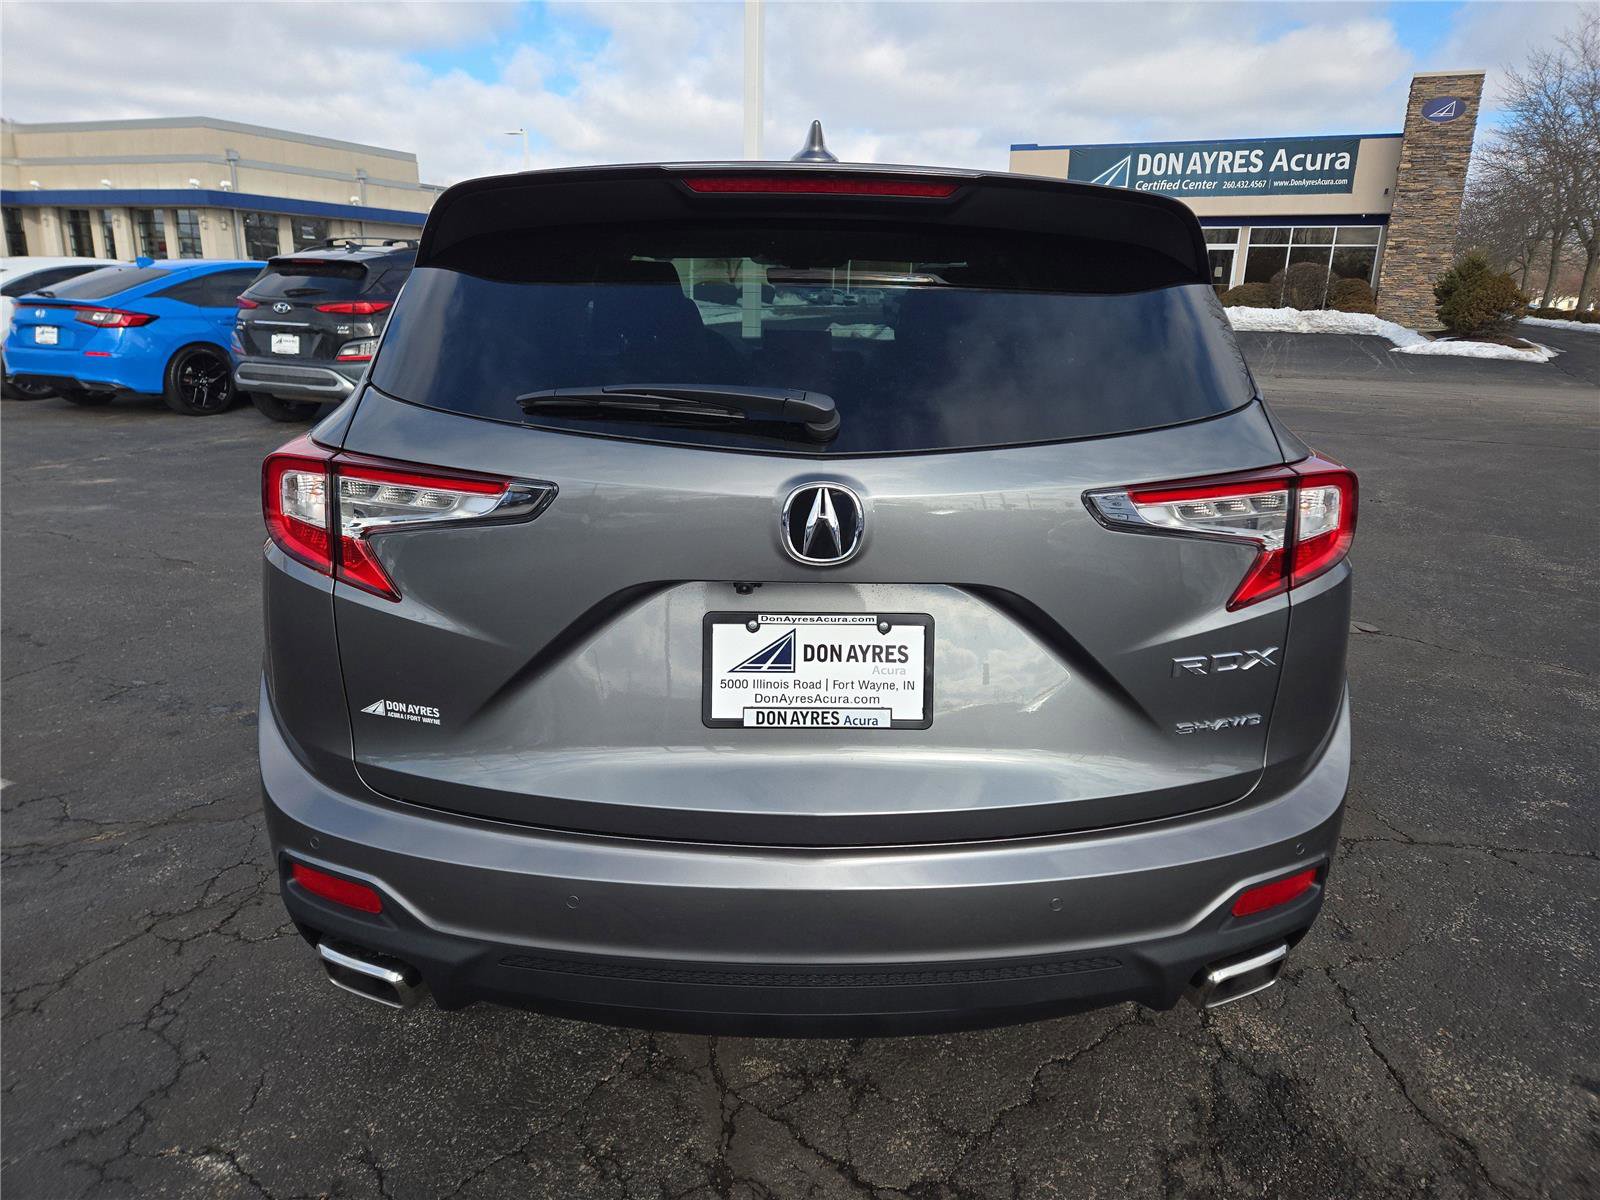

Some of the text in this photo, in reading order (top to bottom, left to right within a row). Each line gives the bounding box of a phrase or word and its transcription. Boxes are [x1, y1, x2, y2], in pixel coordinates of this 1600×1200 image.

[1137, 148, 1351, 176] DON AYRES Acura
[1135, 178, 1348, 191] Certified Center 260.432.4567 www.DonAyresAcura.com
[760, 615, 875, 624] DonAyresAcura.com
[803, 644, 909, 664] DON AYRES
[1171, 647, 1279, 678] RDX
[872, 665, 906, 676] Acura
[720, 678, 915, 692] 5000 Illinois Road Fort Wayne, IN
[754, 693, 880, 705] DonAyresAcura.com
[386, 701, 440, 718] DON AYRES
[756, 711, 879, 727] DON AYRES Acura
